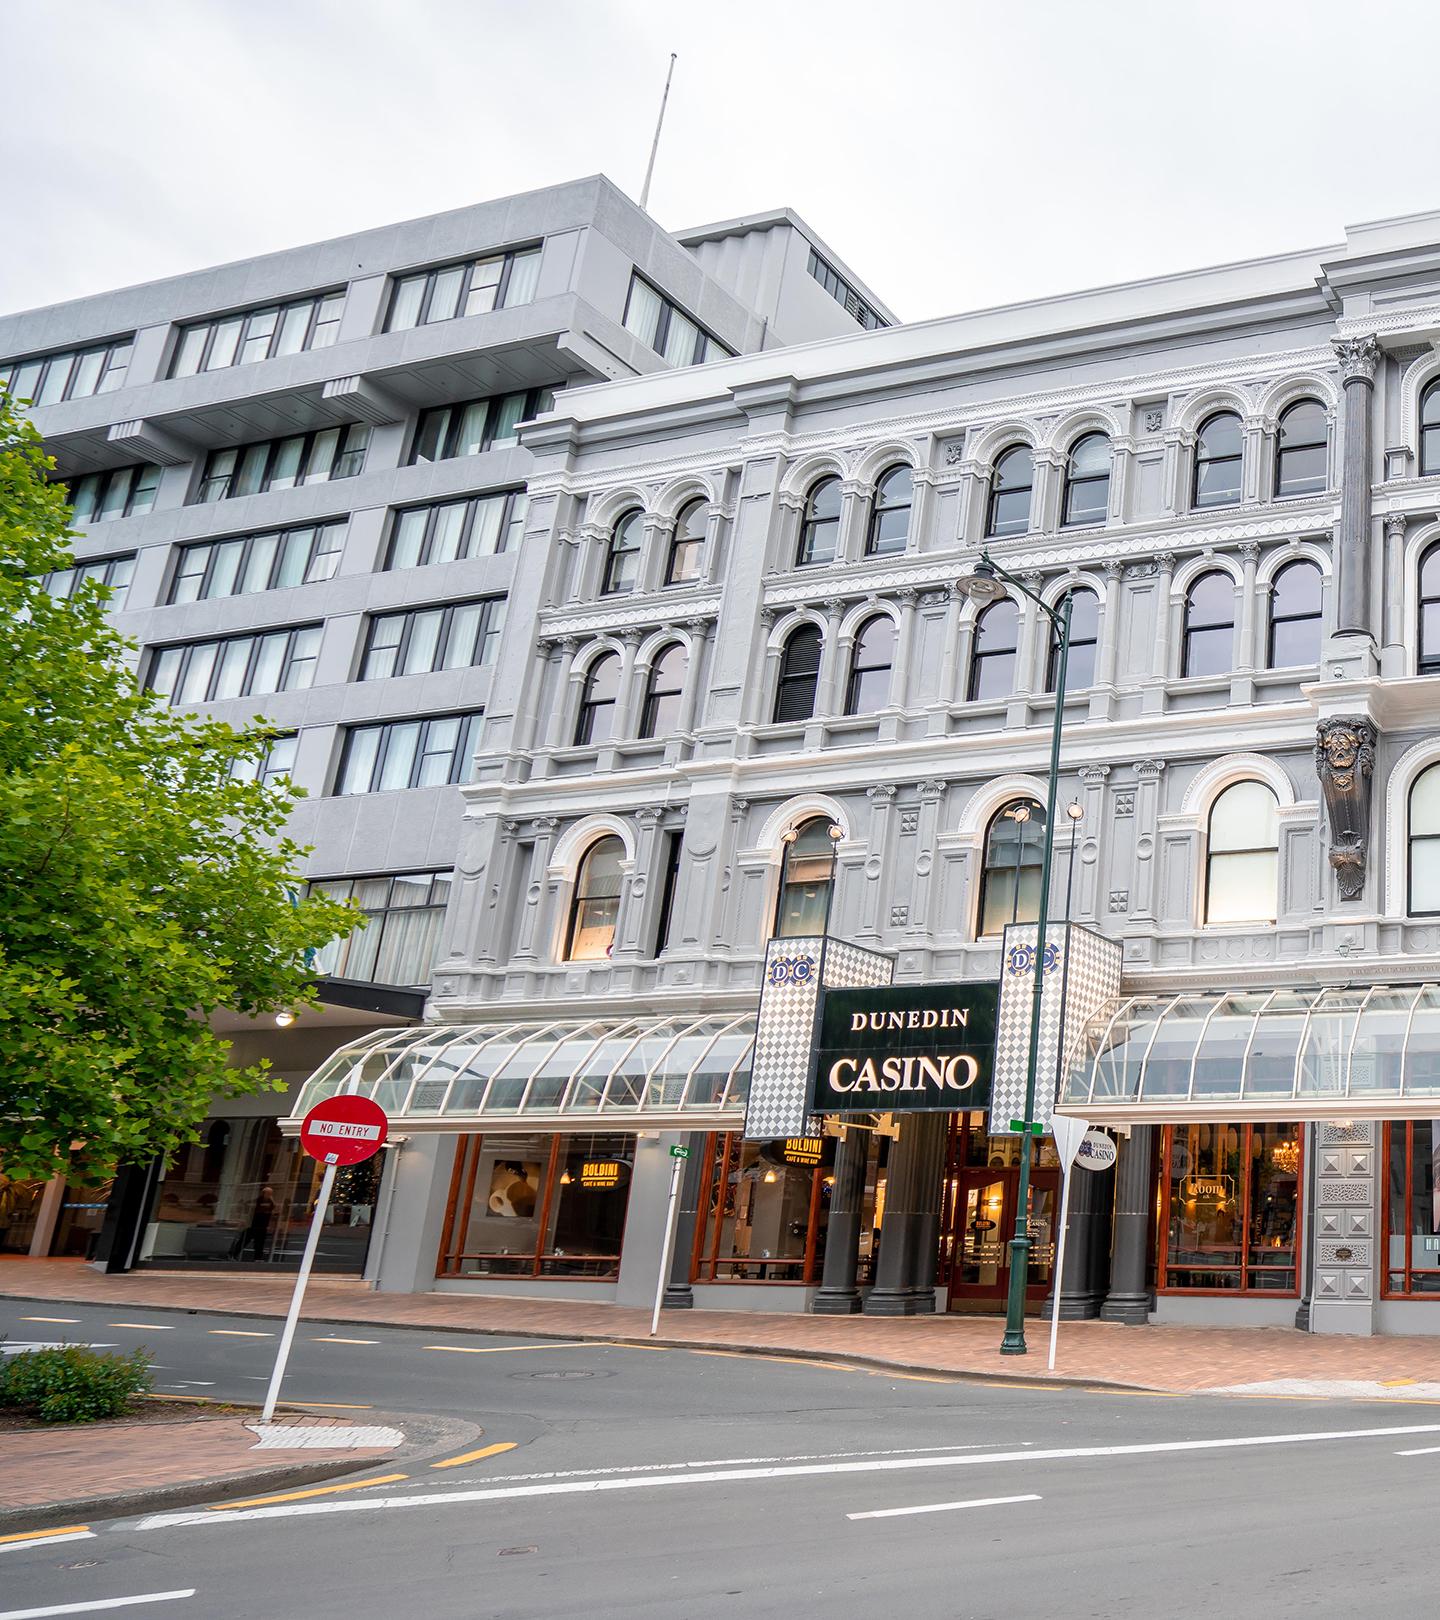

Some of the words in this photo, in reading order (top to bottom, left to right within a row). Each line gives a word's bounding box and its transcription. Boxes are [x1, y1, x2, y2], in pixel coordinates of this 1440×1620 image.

[851, 1008, 970, 1031] DUNEDIN
[828, 1055, 979, 1093] CASINO
[319, 1123, 333, 1134] NO
[339, 1125, 370, 1137] ENTRY
[785, 1138, 822, 1153] BOLDINI
[1091, 1148, 1115, 1161] CASINO
[582, 1163, 619, 1176] BOLDINI
